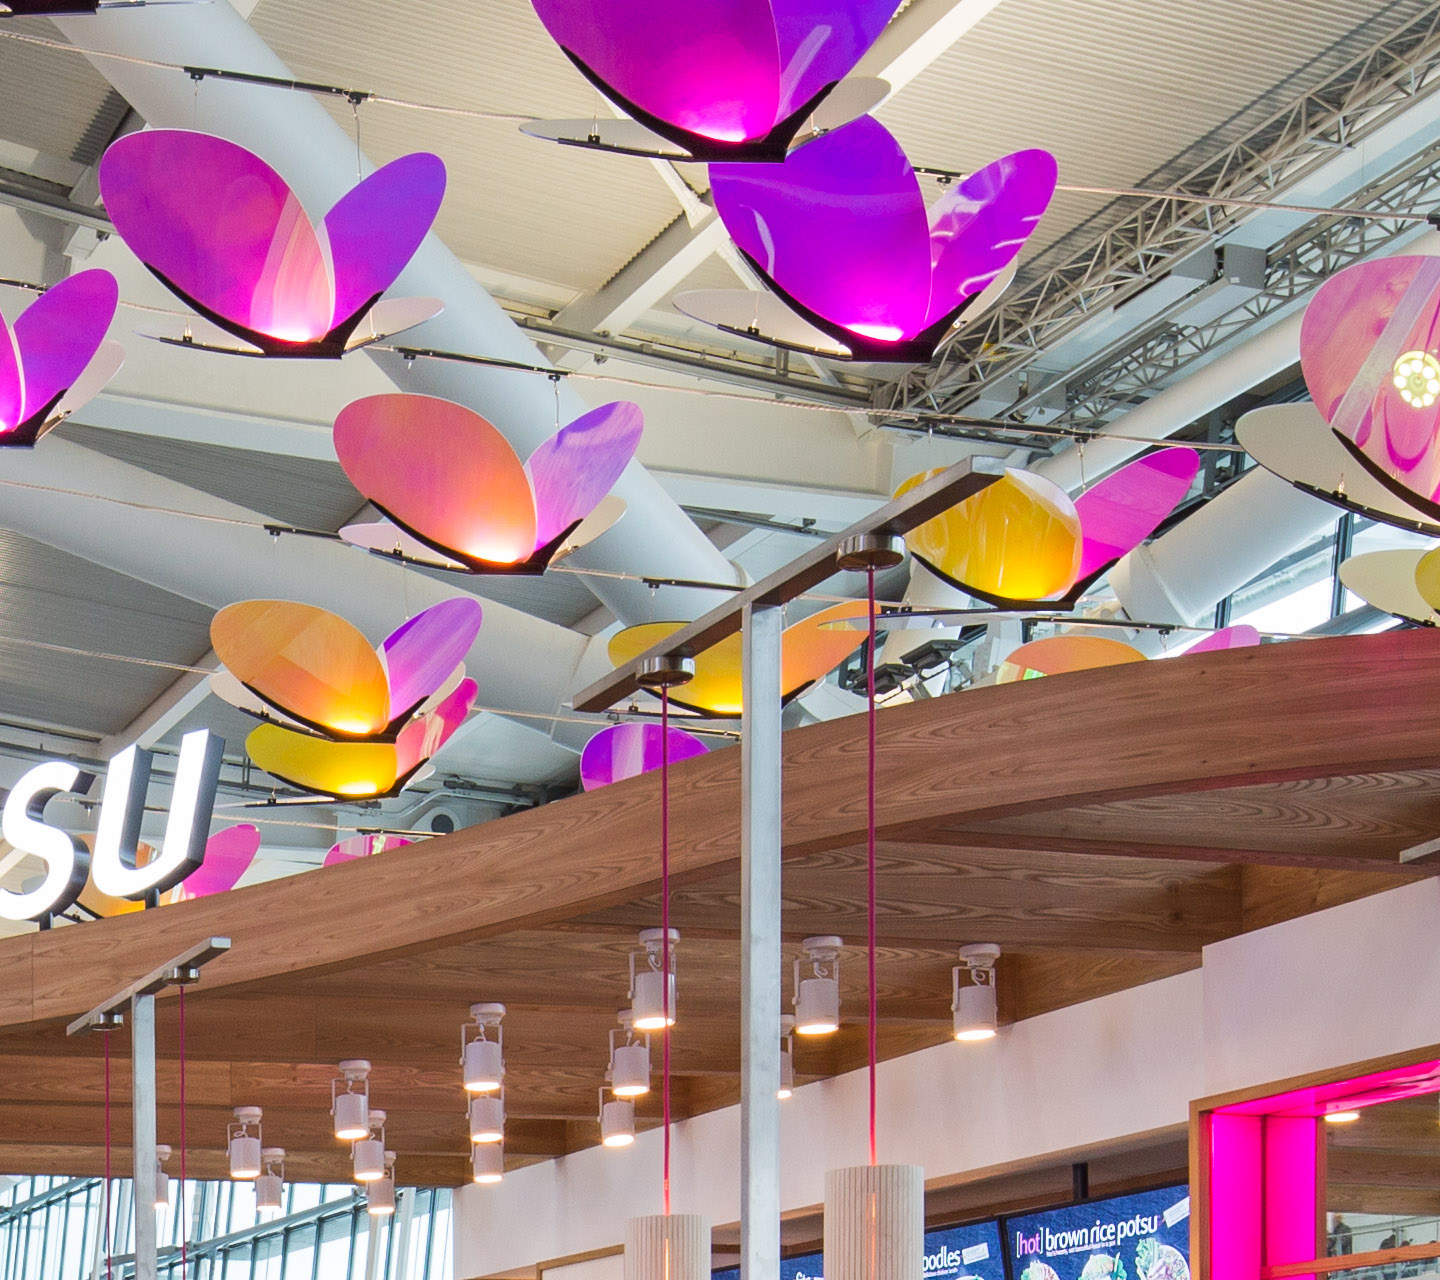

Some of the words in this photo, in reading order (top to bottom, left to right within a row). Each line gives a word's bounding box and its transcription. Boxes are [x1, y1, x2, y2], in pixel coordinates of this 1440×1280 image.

[1016, 1226, 1044, 1258] [hot]
[1045, 1227, 1089, 1252] brown
[1090, 1219, 1116, 1244] rice
[1116, 1214, 1159, 1246] potsu
[923, 1245, 961, 1272] oodles
